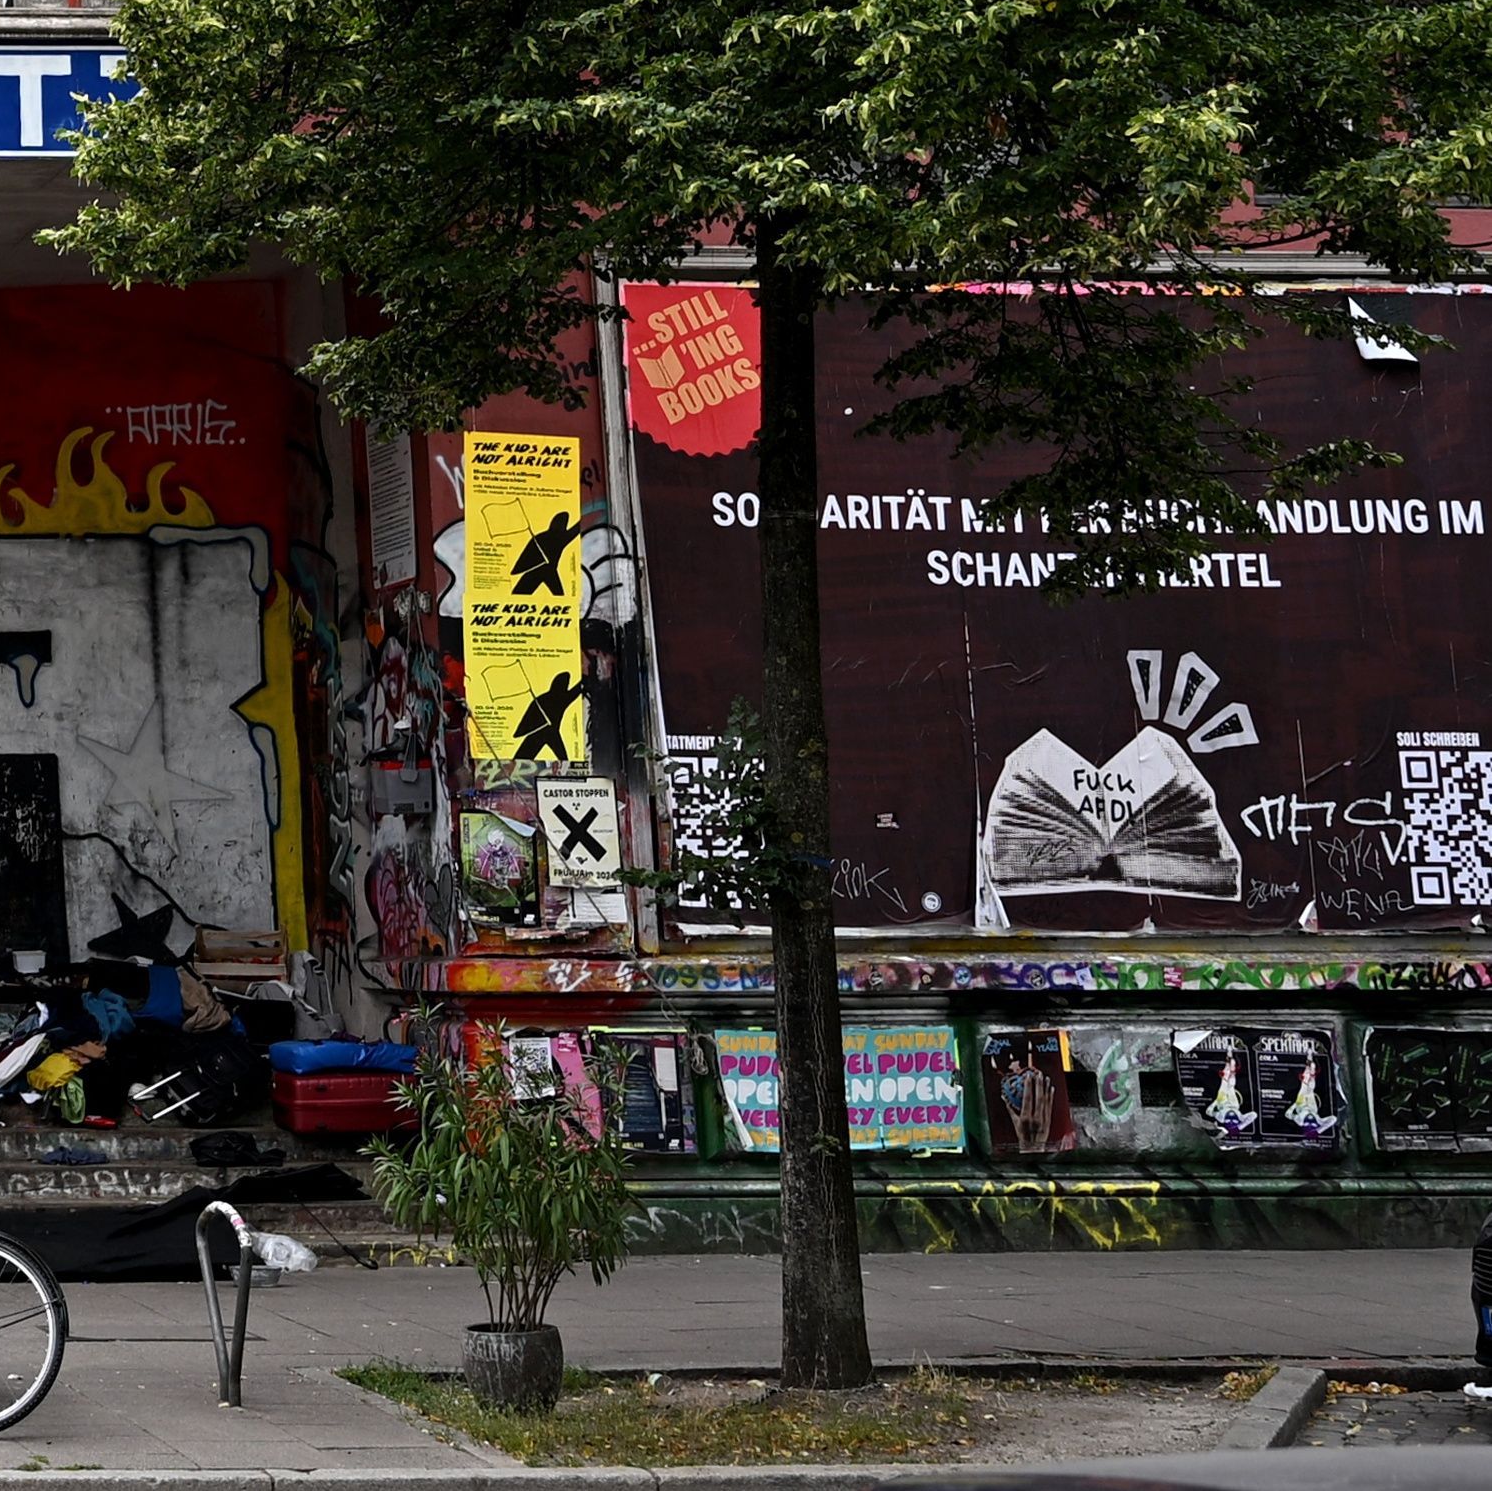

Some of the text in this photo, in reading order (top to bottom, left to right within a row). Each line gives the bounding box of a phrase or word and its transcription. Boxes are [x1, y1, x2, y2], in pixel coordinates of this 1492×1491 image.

[657, 357, 761, 425] BOOKS
[473, 442, 572, 456] THE KIDS ARE
[472, 454, 572, 468] NOT ALRIGHT
[712, 488, 953, 531] SOARITÄT
[1439, 500, 1485, 535] IM
[471, 604, 572, 615] THE KIDS ARE
[470, 616, 572, 628] NOT ALRIGHT
[1396, 732, 1480, 747] SOLI SCHREIBEN
[1074, 769, 1136, 794] FUCK
[543, 789, 609, 798] CASTOR STOPPEN
[874, 1031, 950, 1051] SUNDAY
[878, 1052, 957, 1075] PUDEL
[879, 1076, 958, 1105] OPEN
[883, 1105, 959, 1126] EVERY
